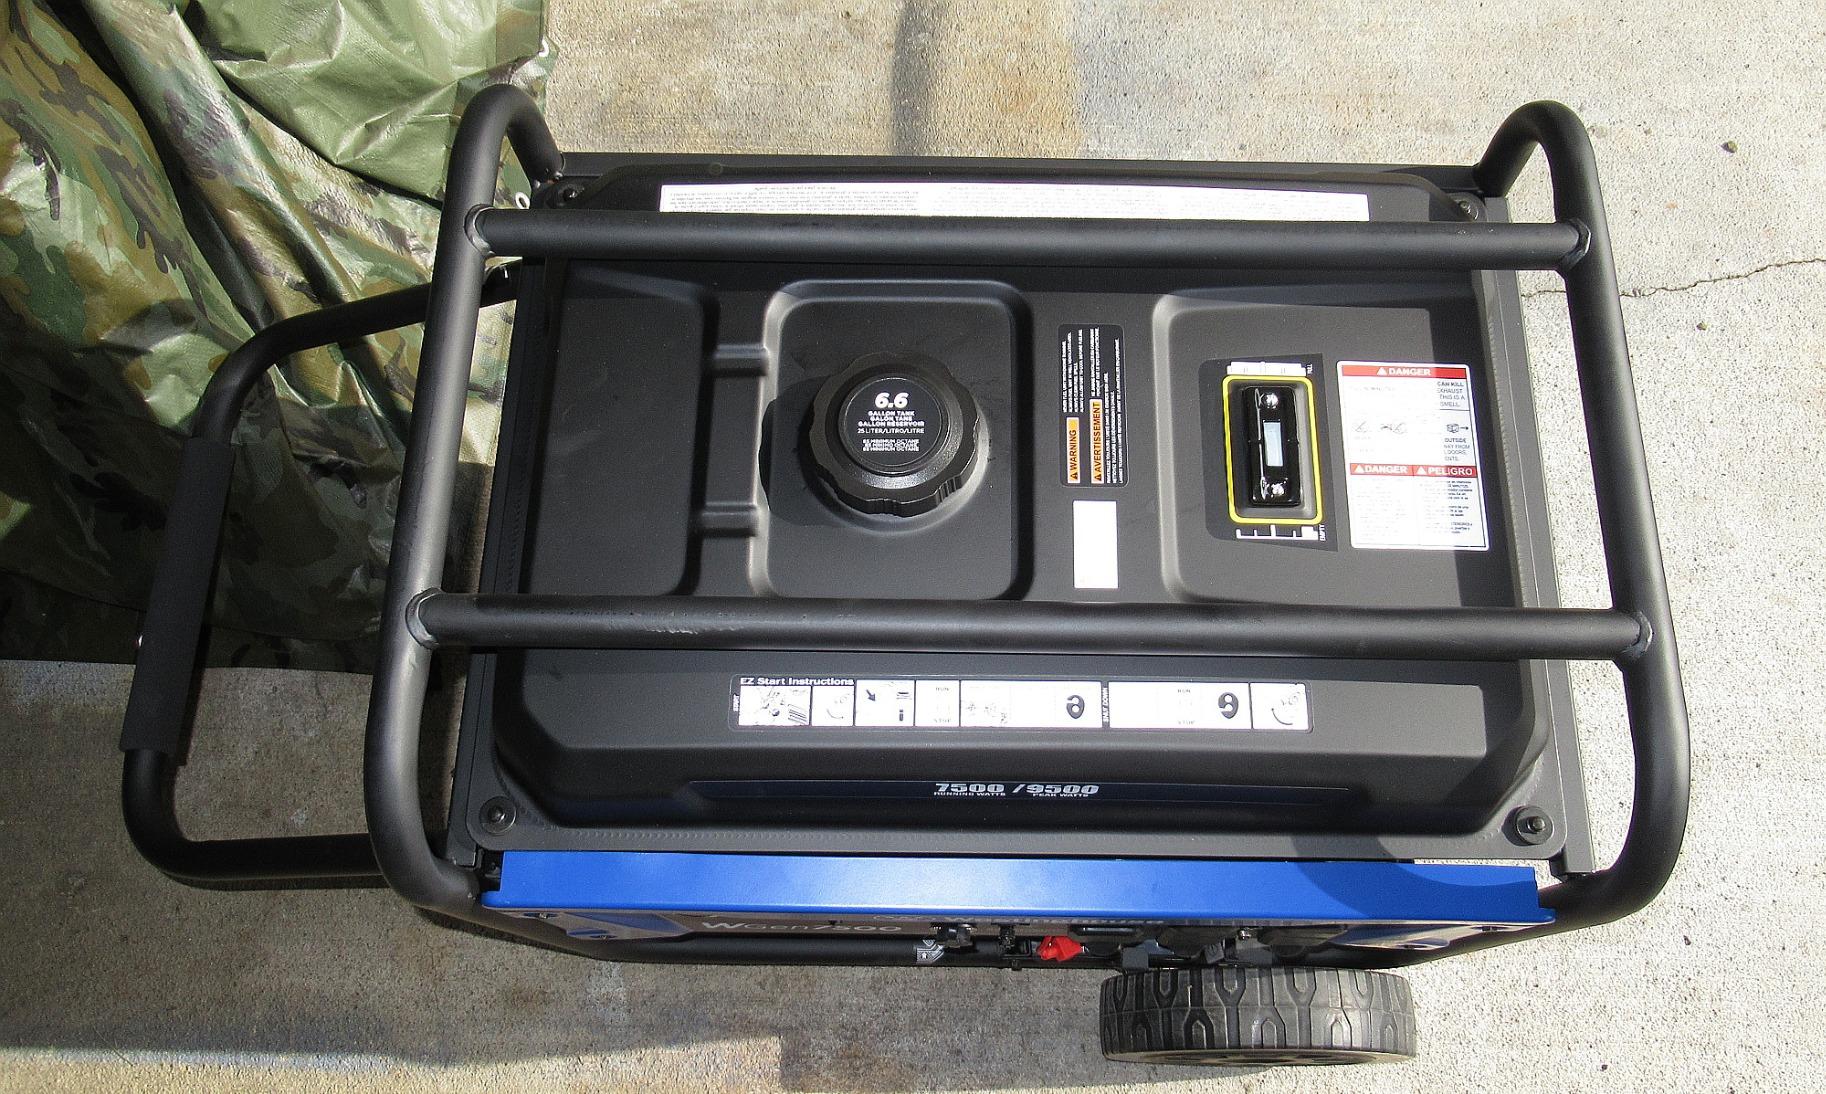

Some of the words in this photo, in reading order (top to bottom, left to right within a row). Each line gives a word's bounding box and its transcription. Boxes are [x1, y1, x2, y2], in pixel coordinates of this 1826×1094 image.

[1388, 367, 1431, 376] DANGER
[875, 392, 909, 409] 6.6
[1092, 402, 1102, 473] AVERTISSEMENT
[1069, 429, 1077, 471] WARNING
[1365, 465, 1408, 473] DANGER
[1428, 467, 1473, 475] PELIGRO
[740, 677, 754, 685] EZ
[757, 677, 786, 685] Start
[788, 677, 855, 686] Instructions
[935, 783, 1005, 793] 7500
